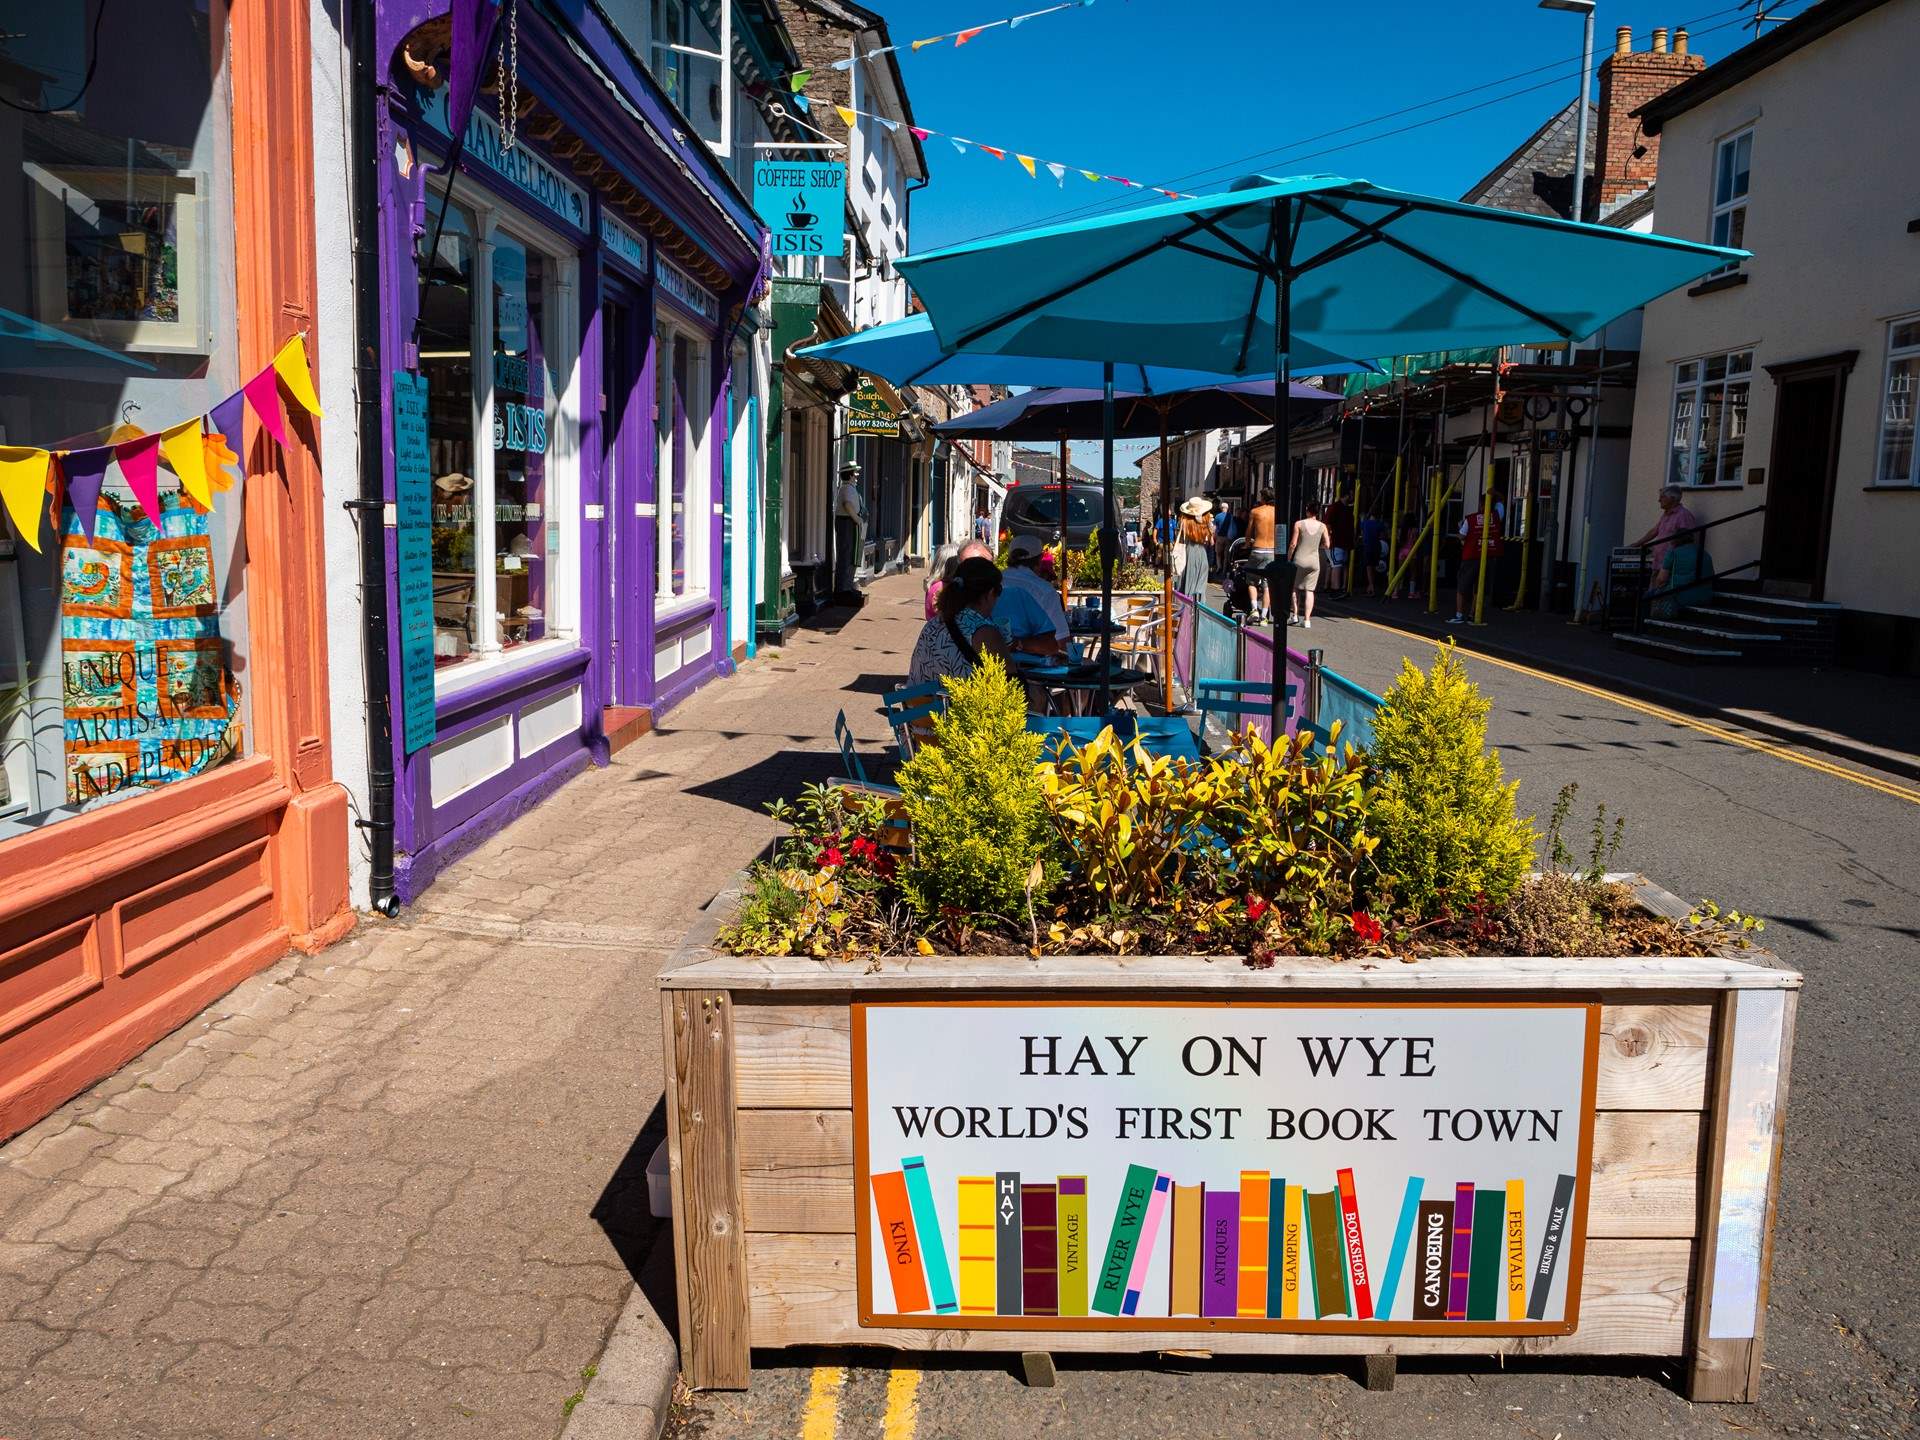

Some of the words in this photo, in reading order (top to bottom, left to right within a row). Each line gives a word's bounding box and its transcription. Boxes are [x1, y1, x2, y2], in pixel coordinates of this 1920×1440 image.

[757, 168, 806, 187] COFFEE
[811, 169, 842, 188] SHOP
[776, 233, 823, 251] ISIS
[687, 279, 703, 310] SHOP
[506, 402, 547, 454] ISIS
[850, 419, 871, 427] 01497
[871, 400, 880, 410] &
[63, 646, 170, 696] UNIQUE
[72, 694, 191, 752] ARTISAN
[74, 724, 245, 806] INDEPENDENT
[1019, 1035, 1149, 1076] HAY
[1181, 1035, 1267, 1077] ON
[1298, 1036, 1436, 1077] WYE
[892, 1103, 1089, 1140] WORLD'S
[1115, 1107, 1242, 1140] FIRST
[1266, 1107, 1397, 1141] BOOK
[1423, 1108, 1563, 1142] TOWN
[1103, 1238, 1131, 1292] RIVER
[1121, 1186, 1145, 1227] WYE
[1549, 1232, 1557, 1243] &
[1550, 1206, 1565, 1231] WALK
[890, 1220, 912, 1266] KING
[1067, 1213, 1079, 1274] VINTAGE
[1214, 1219, 1228, 1286] ANTIQUES
[1285, 1223, 1298, 1292] GLAMPING
[1345, 1212, 1366, 1286] BOOKSHOPS
[1423, 1212, 1444, 1308] CANOEING
[1509, 1210, 1524, 1292] FESTIVALS
[1539, 1244, 1555, 1275] BIKING
